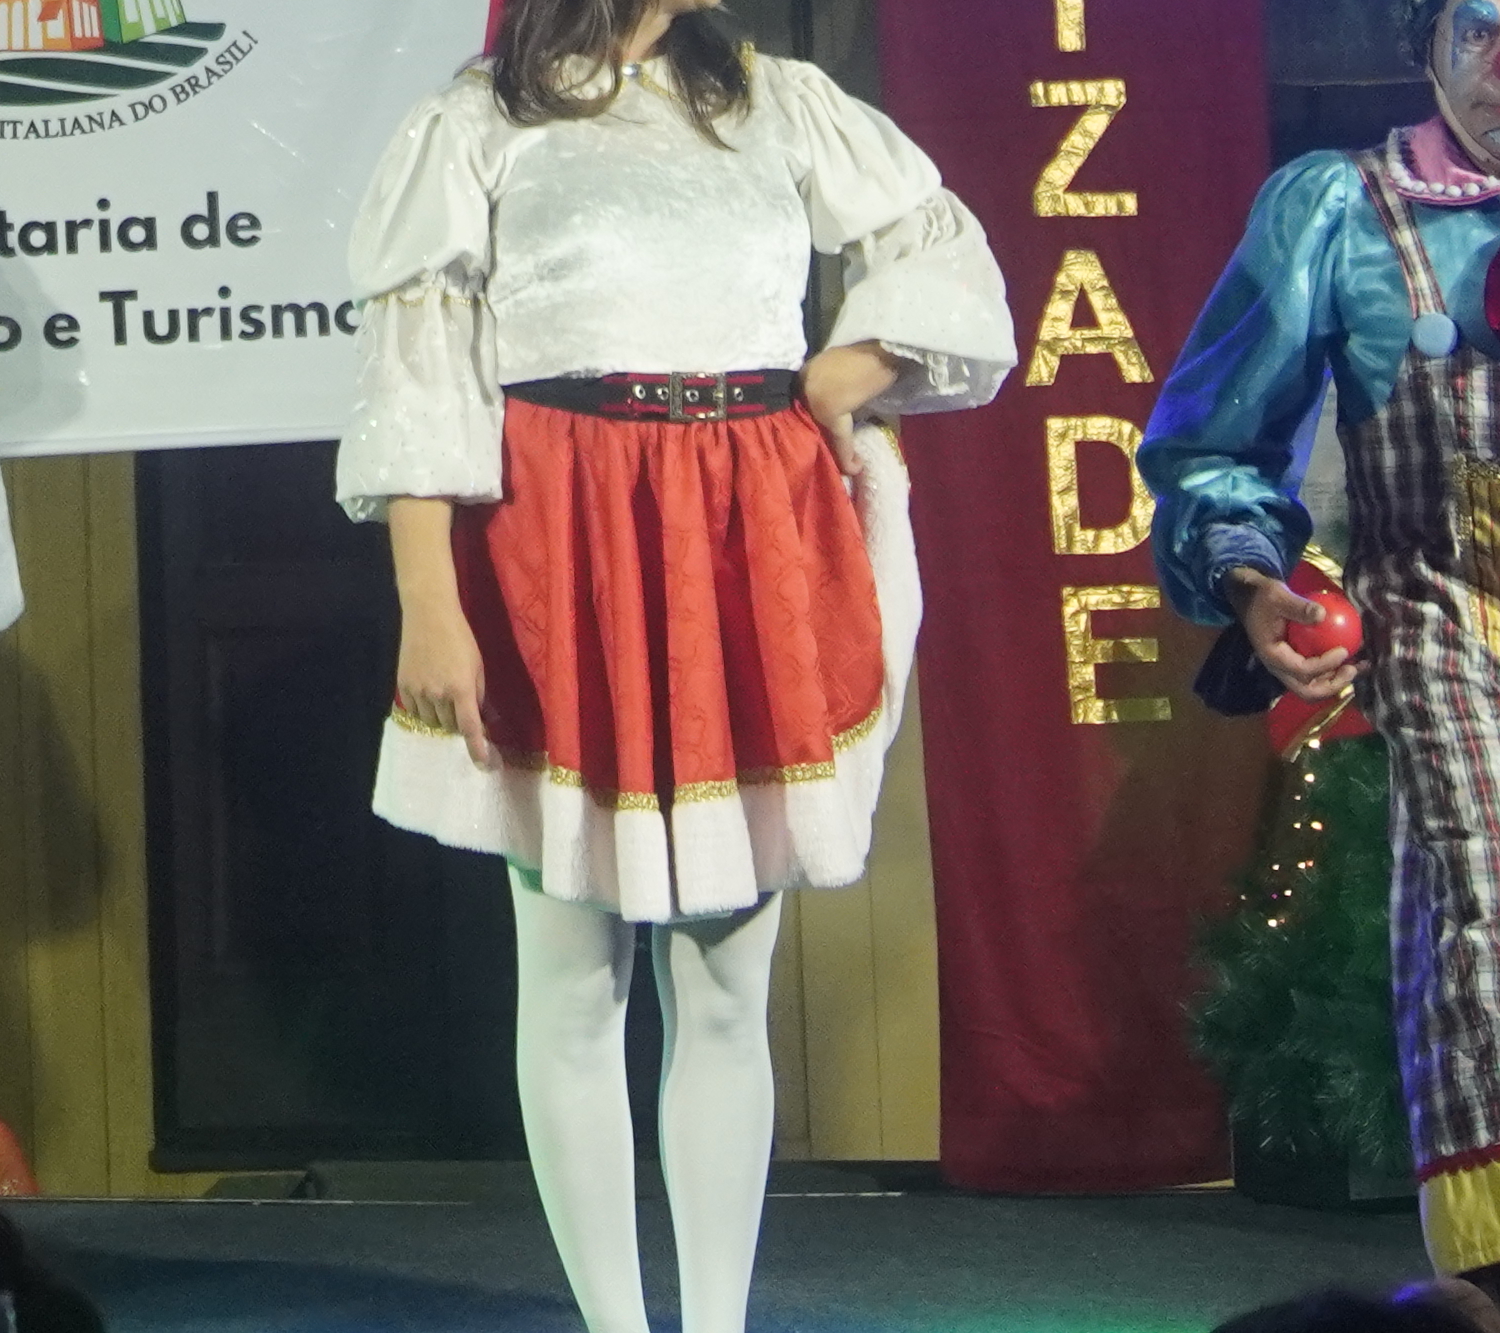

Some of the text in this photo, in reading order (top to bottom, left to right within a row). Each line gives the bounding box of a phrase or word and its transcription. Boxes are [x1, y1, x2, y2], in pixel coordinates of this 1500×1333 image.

[129, 93, 168, 123] DO
[180, 191, 262, 250] de
[43, 312, 81, 349] e
